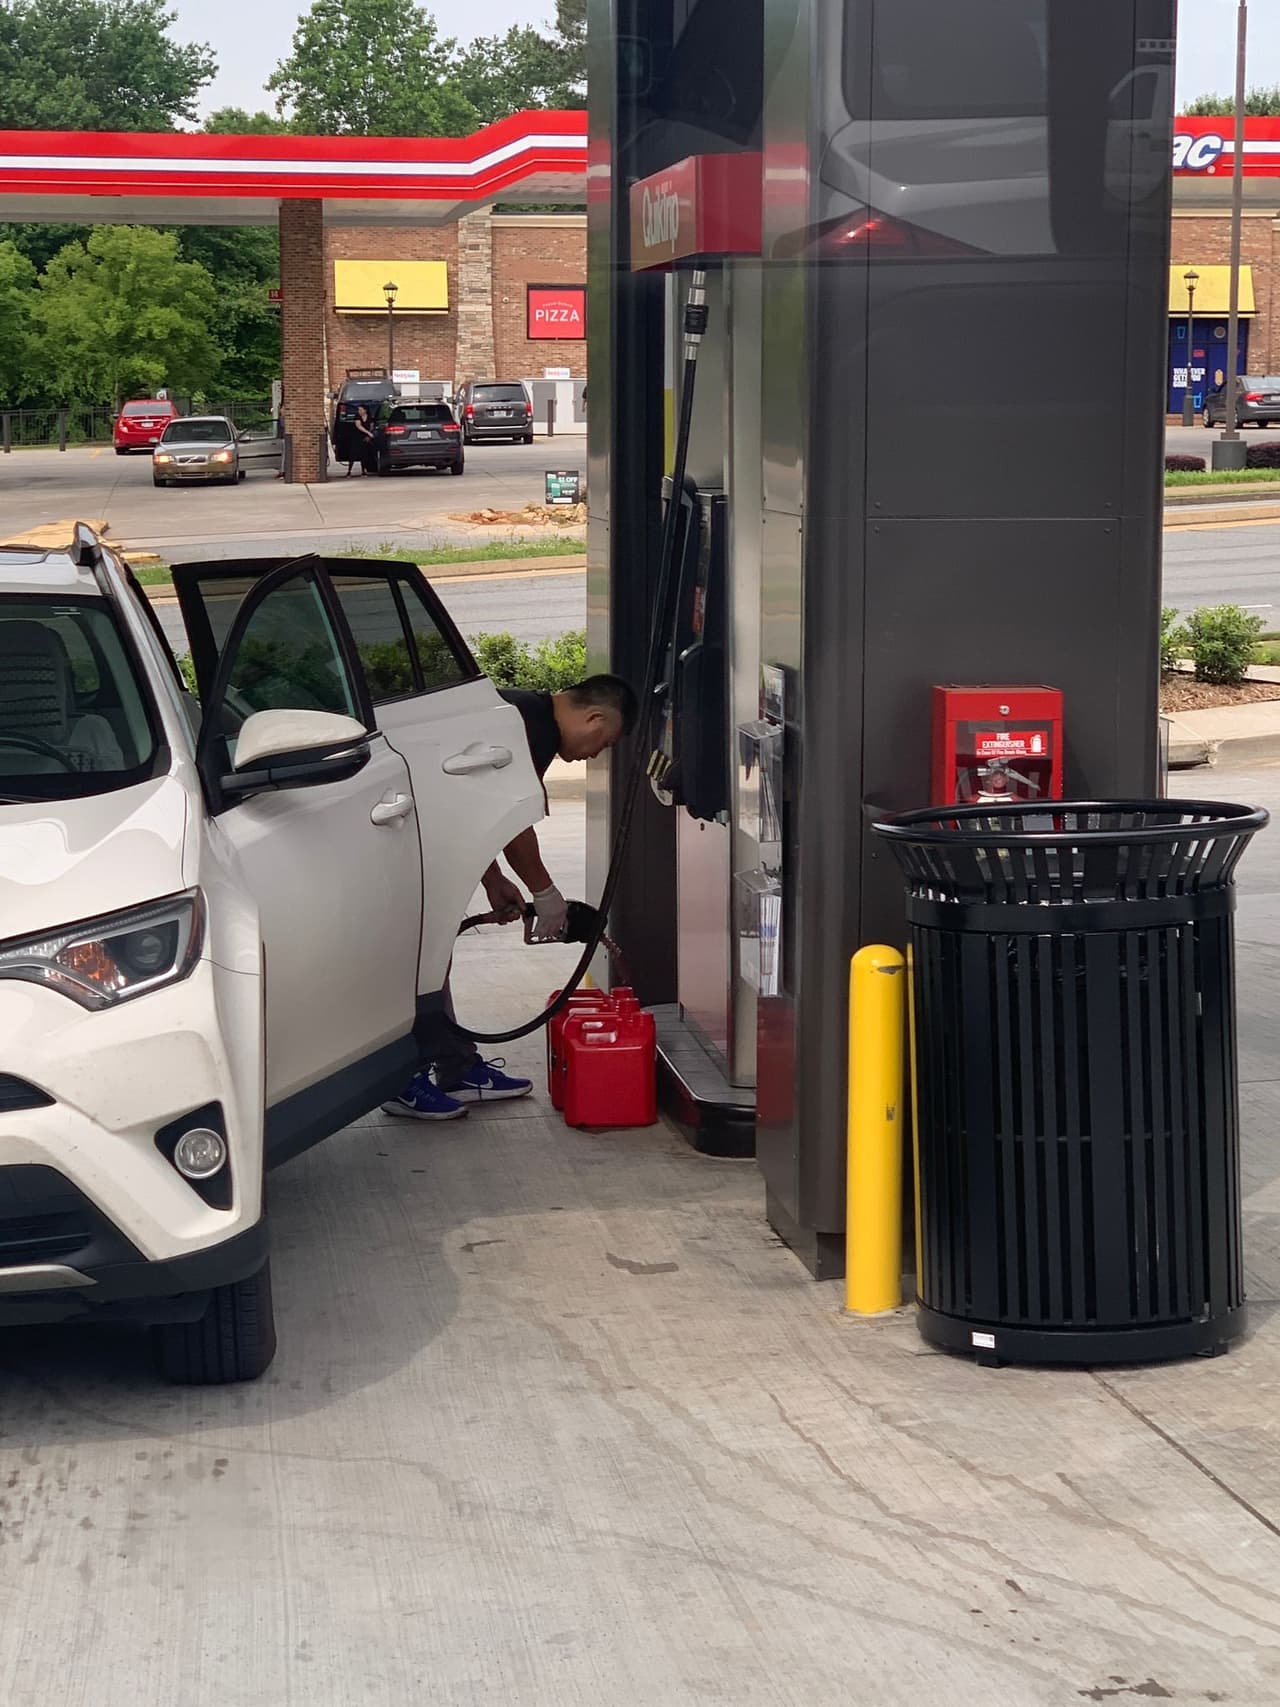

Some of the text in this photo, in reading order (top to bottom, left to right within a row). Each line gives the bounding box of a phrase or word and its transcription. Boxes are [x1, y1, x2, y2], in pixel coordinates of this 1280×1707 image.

[642, 181, 680, 254] QuikTrip
[535, 309, 580, 322] PIZZA
[996, 732, 1010, 741] FIRE
